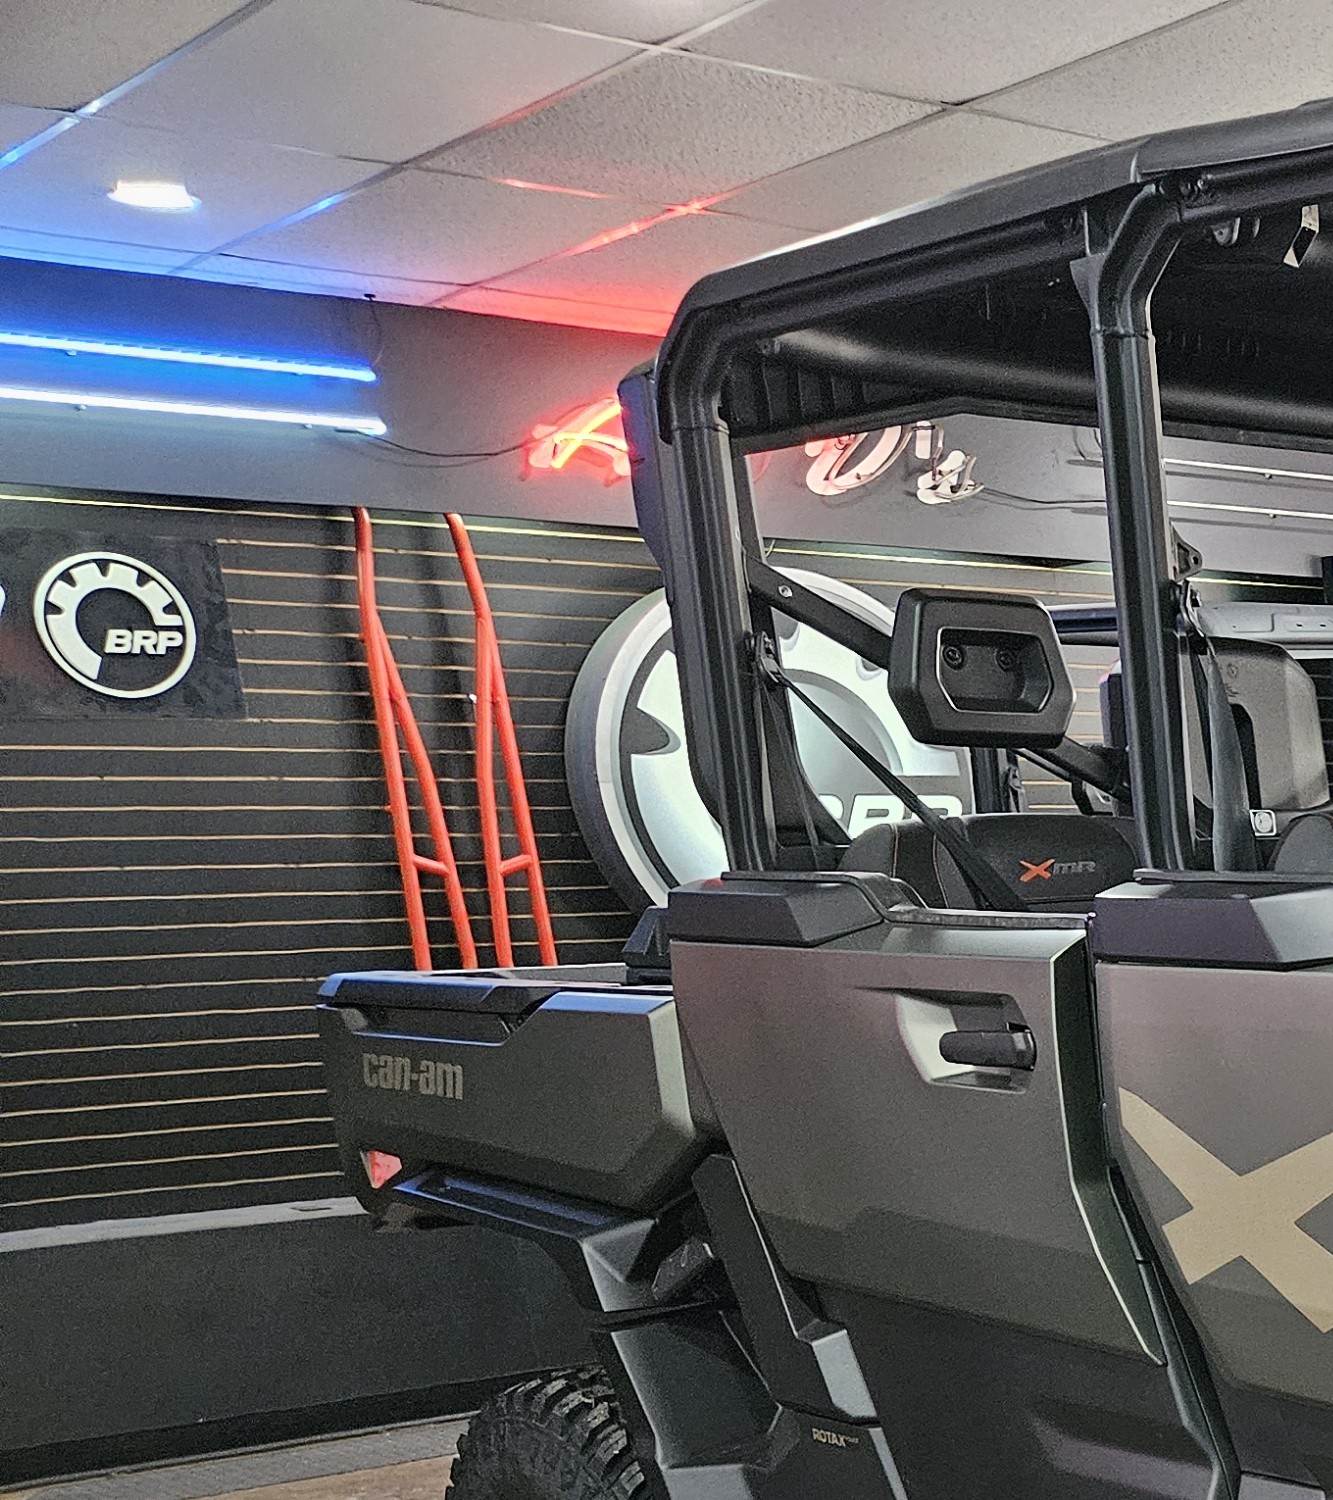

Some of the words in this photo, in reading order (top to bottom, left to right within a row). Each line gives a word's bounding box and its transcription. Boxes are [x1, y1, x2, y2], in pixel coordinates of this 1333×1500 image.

[105, 629, 184, 655] BRP
[362, 1052, 463, 1100] can-am
[811, 1427, 847, 1447] ROTAX
